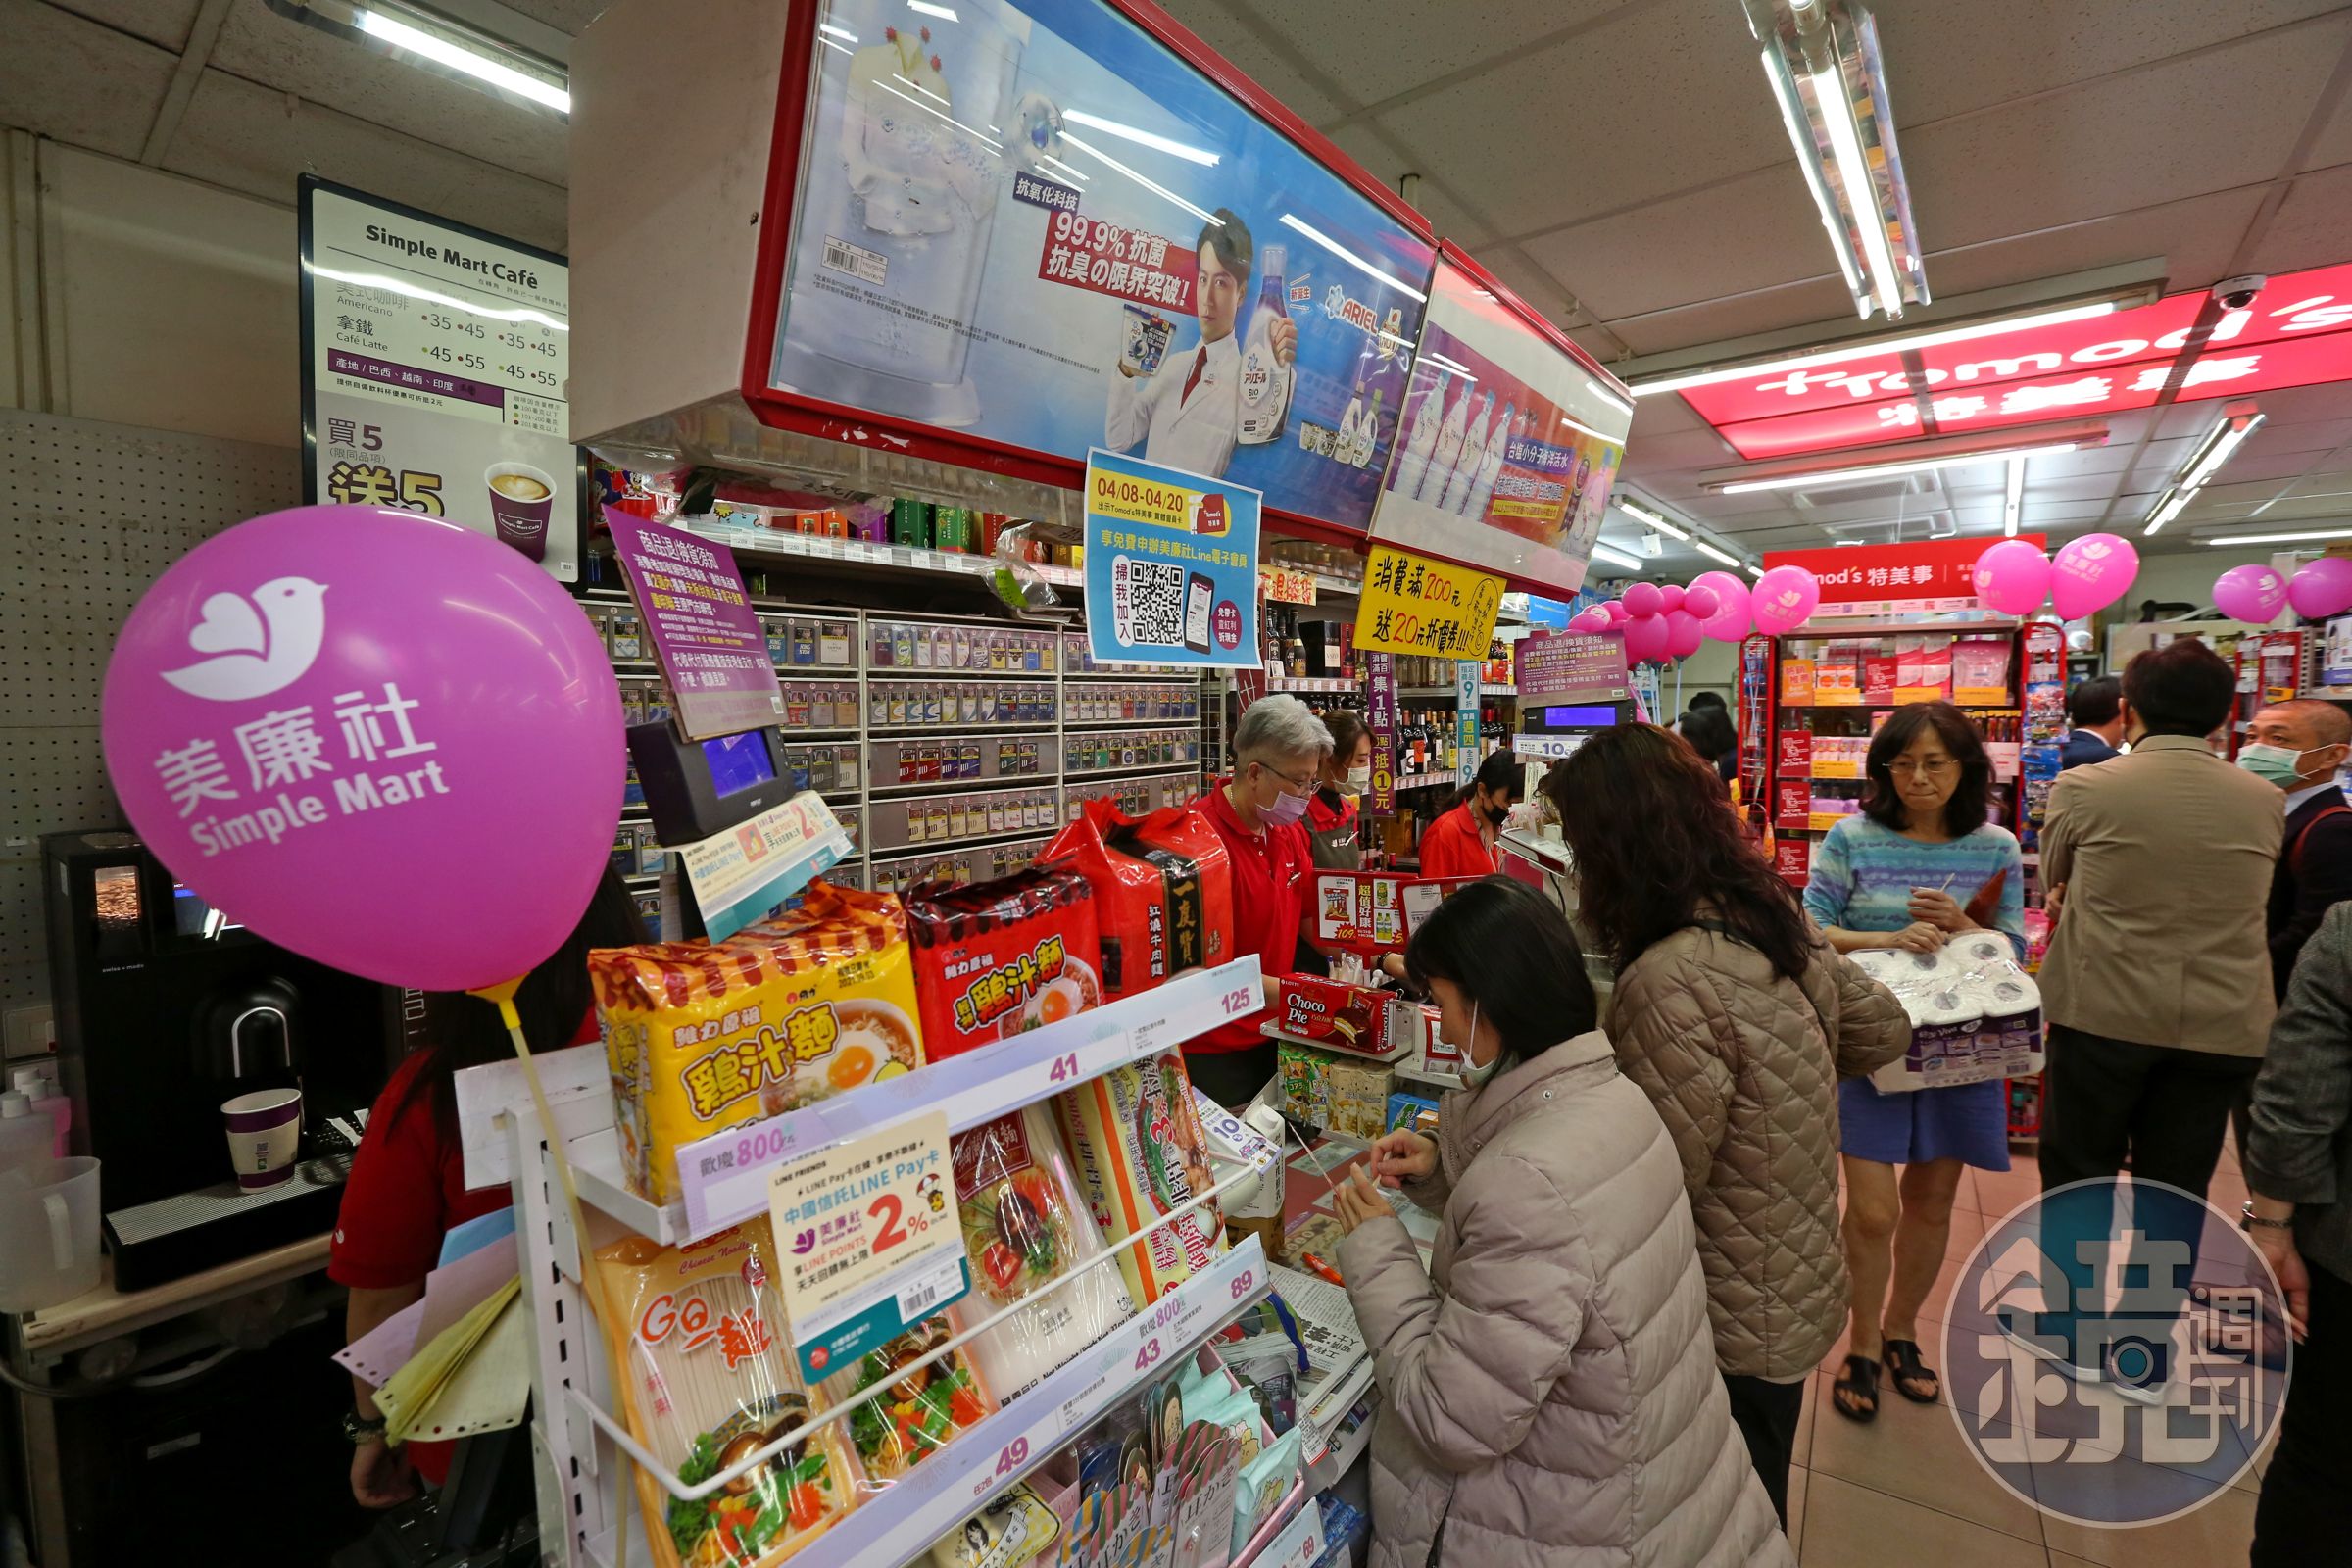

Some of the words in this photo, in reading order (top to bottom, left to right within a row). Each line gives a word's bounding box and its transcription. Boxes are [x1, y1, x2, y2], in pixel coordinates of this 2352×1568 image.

[1016, 178, 1078, 211] 抗氧化科技
[366, 224, 437, 261] Simple
[443, 247, 488, 274] Mart
[492, 263, 538, 290] Café
[1047, 244, 1190, 307] 抗臭の限界突破!
[336, 295, 393, 318] Americano
[1342, 299, 1379, 335] ARIEL
[336, 315, 374, 338] 拿鐵
[336, 331, 363, 347] Café
[365, 337, 389, 352] Latte
[430, 313, 452, 330] 35
[464, 321, 485, 339] 45
[505, 332, 526, 350] 35
[537, 341, 558, 358] 45
[430, 344, 452, 363] 45
[464, 353, 485, 370] 55
[506, 364, 526, 380] 45
[537, 370, 558, 387] 55
[328, 417, 383, 451] 買5
[328, 460, 445, 517] 送5
[1098, 477, 1184, 513] 04/08-04/20
[1101, 529, 1249, 569] 享免費申辦美廉社Line電子會員
[1373, 555, 1461, 607] 消費滿200元
[1867, 565, 1934, 587] 特美事
[1115, 564, 1131, 640] 掃我加入
[1218, 632, 1238, 644] 折現金
[1535, 636, 1603, 649] 商品退/換貨須知
[1373, 676, 1389, 727] 集1點
[154, 682, 438, 819] 美廉社
[1373, 753, 1392, 808] 抵1元
[190, 793, 328, 858] Simple
[333, 760, 451, 814] Mart
[1358, 884, 1372, 928] 超值好康
[1149, 905, 1164, 978] 紅燒牛肉麵
[1338, 929, 1354, 939] 109
[1221, 987, 1250, 1015] 125
[1287, 994, 1325, 1013] Choco
[1289, 1007, 1308, 1024] Pie
[1380, 1019, 1389, 1050] Choco
[1050, 1054, 1079, 1082] 41
[1213, 1119, 1240, 1139] 10
[785, 1169, 890, 1225] 中國信託LINE
[896, 1150, 939, 1179] Pay卡
[820, 1209, 860, 1236] 美廉社
[821, 1232, 845, 1246] Simple
[847, 1224, 862, 1234] Mart
[867, 1194, 907, 1255] 2
[679, 1250, 716, 1275] Chinese
[829, 1235, 867, 1260] POINTS
[797, 1250, 868, 1294] 天天回饋無上限
[1231, 1270, 1253, 1299] 89
[1134, 1338, 1161, 1371] 43
[995, 1437, 1029, 1477] 49
[1302, 1535, 1314, 1560] 69
